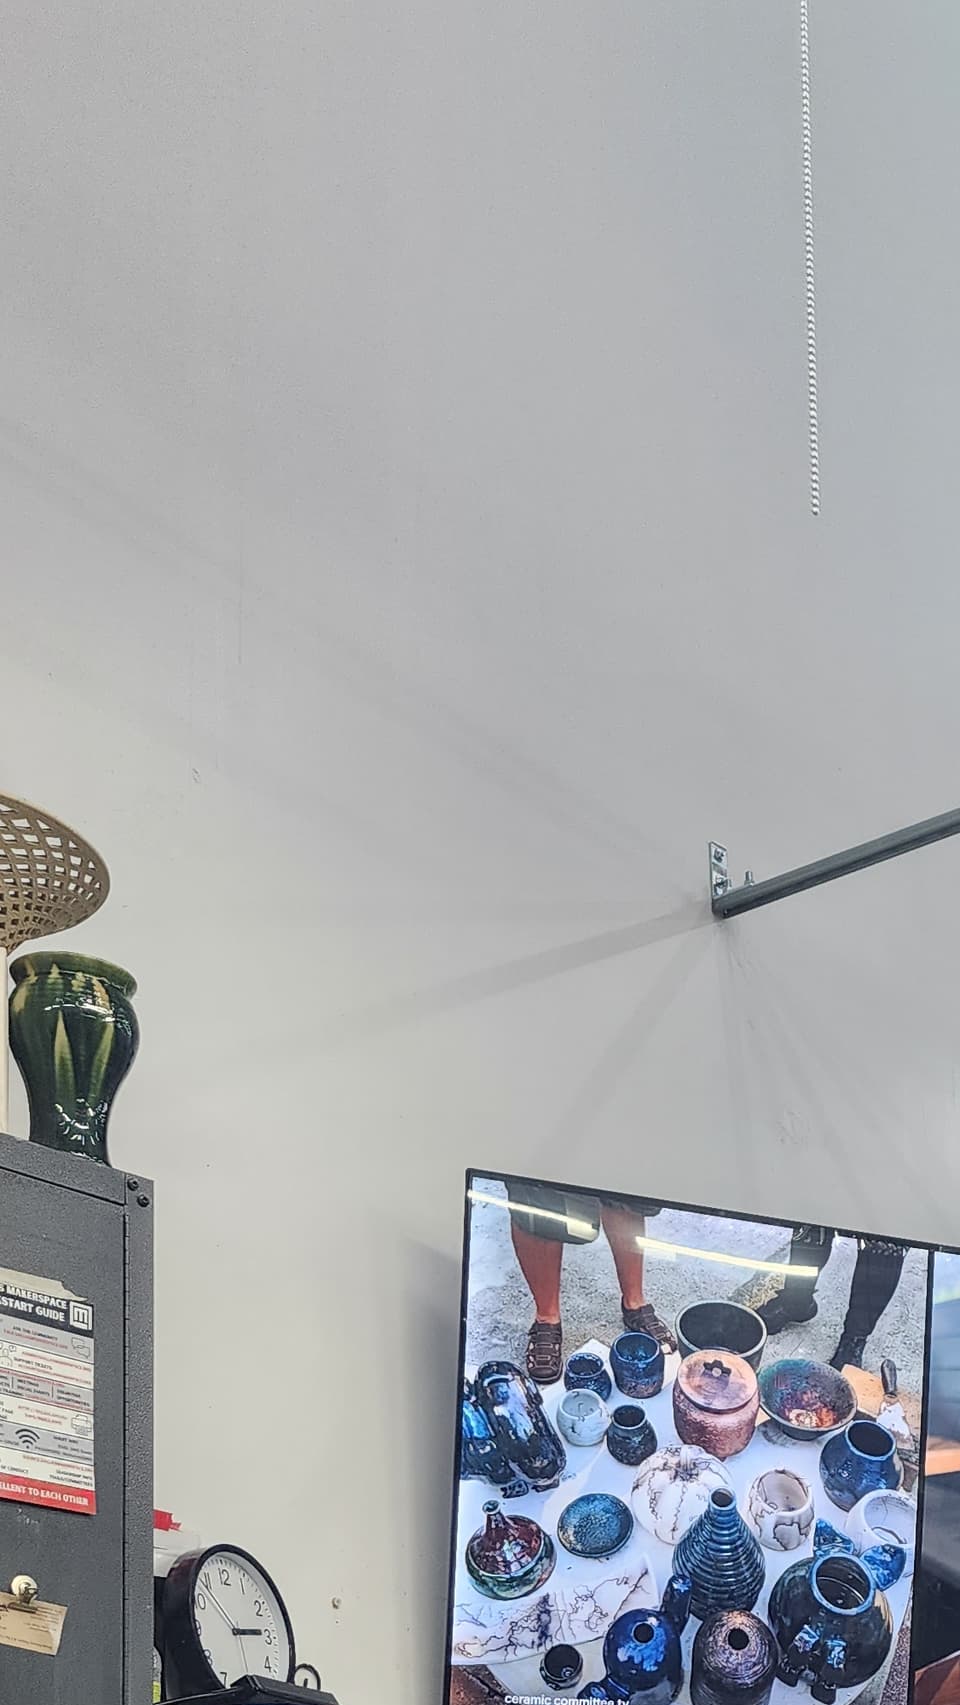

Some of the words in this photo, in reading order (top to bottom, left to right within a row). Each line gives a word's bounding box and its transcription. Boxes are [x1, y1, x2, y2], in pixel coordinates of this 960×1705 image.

[7, 1284, 68, 1309] MAKERSPACE
[0, 1296, 34, 1314] START
[36, 1307, 65, 1322] GUIDE
[28, 1487, 39, 1496] TO
[40, 1489, 61, 1501] EACH
[63, 1495, 89, 1506] OTHER
[218, 1567, 232, 1586] 12
[254, 1600, 263, 1617] 2
[264, 1628, 272, 1645] 3
[264, 1655, 272, 1673] 4
[220, 1671, 228, 1688] 7
[504, 1694, 552, 1705] ceramic
